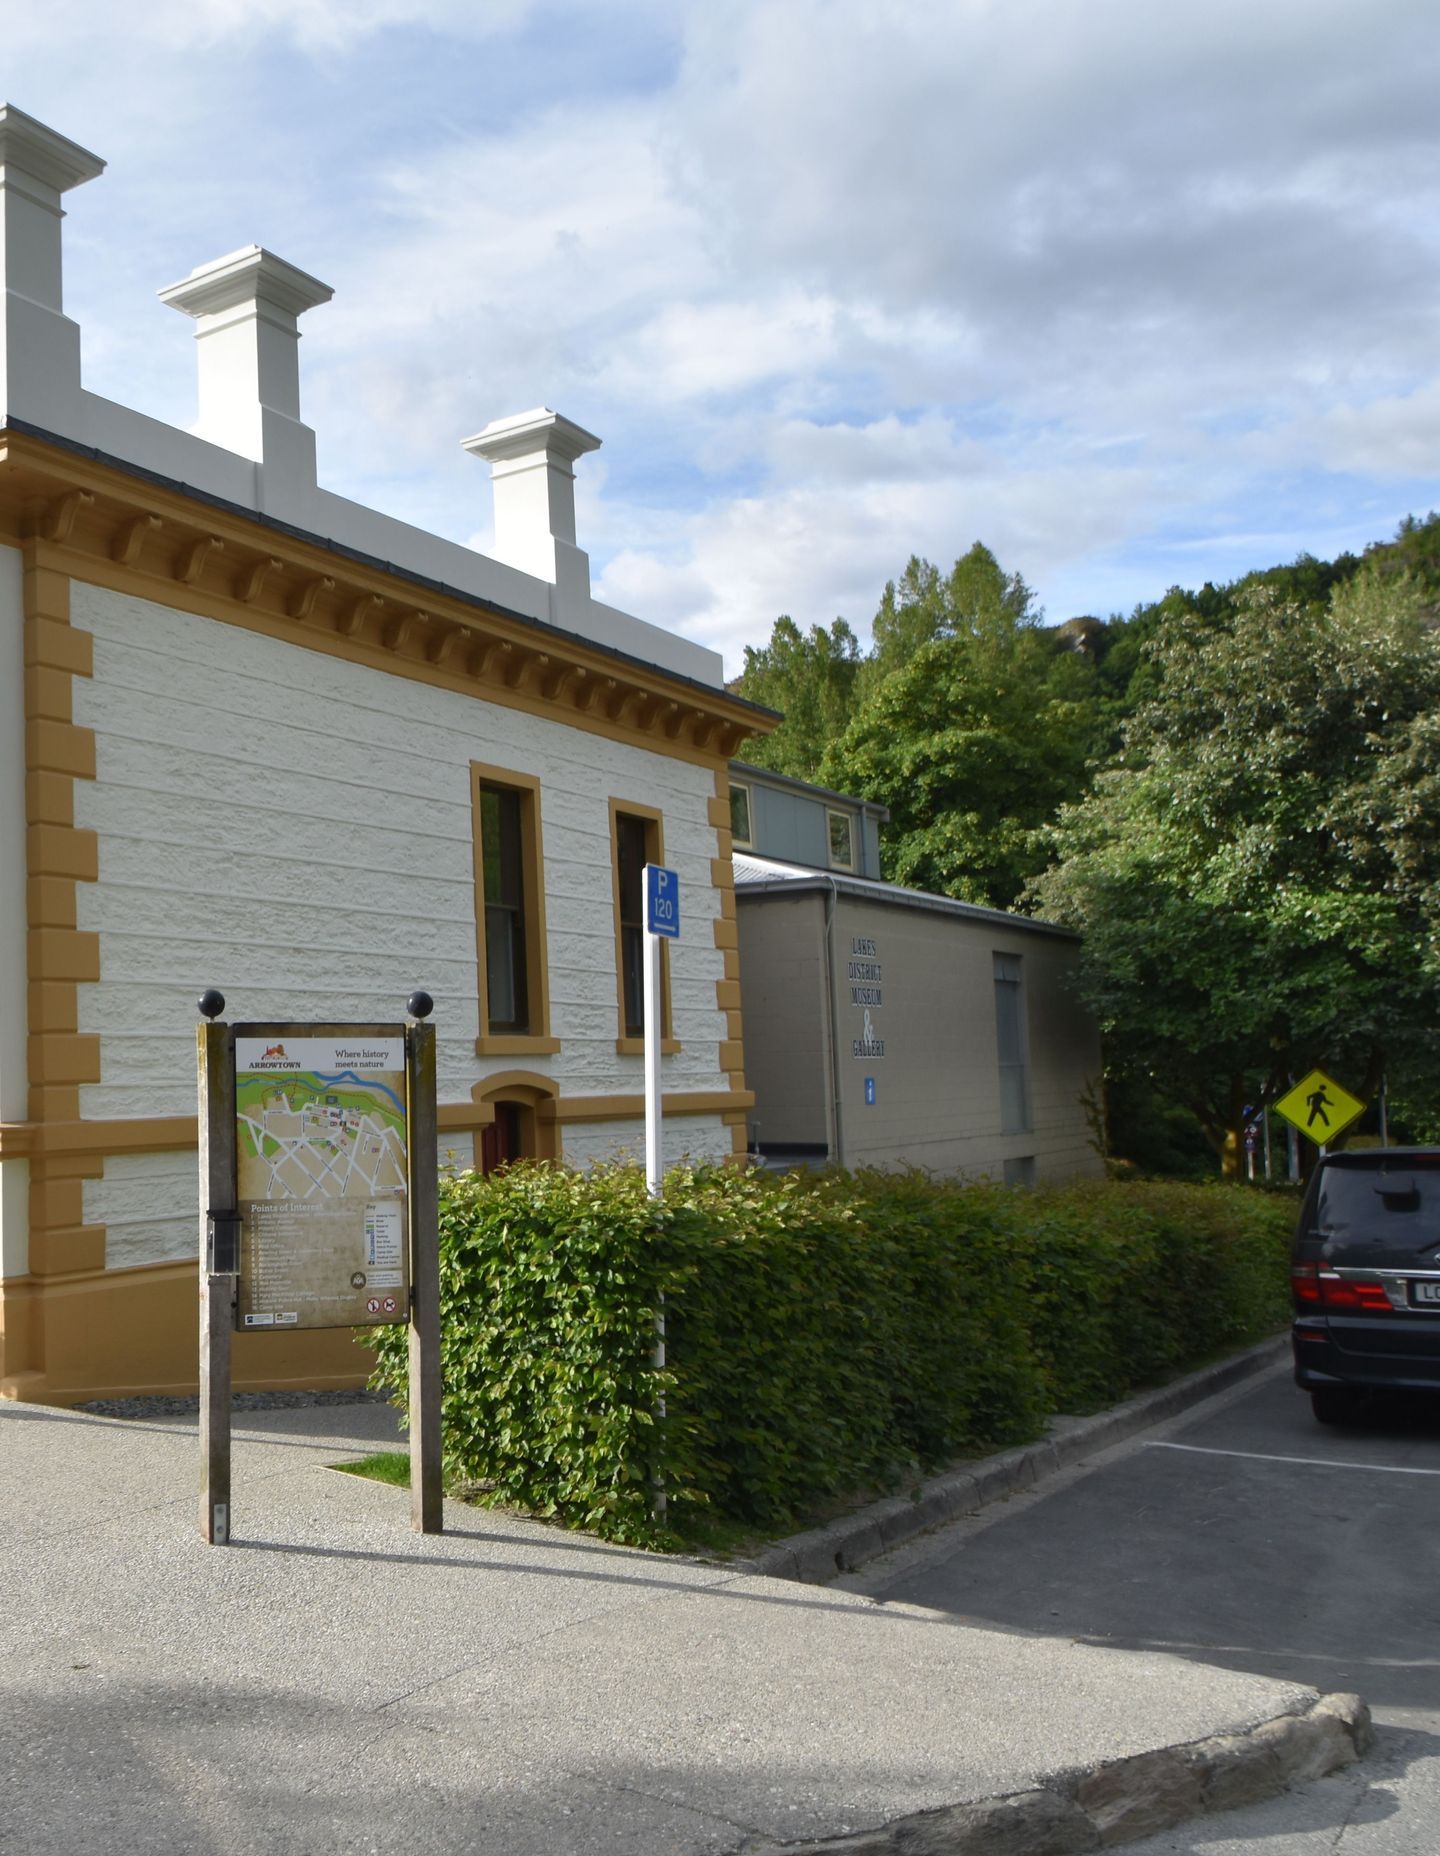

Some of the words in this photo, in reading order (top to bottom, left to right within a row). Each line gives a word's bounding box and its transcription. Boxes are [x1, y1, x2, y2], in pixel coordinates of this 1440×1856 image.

[658, 871, 668, 895] P
[654, 897, 672, 920] 120
[852, 937, 876, 957] LAKES
[848, 962, 882, 982] DISTRICT
[851, 987, 882, 1007] MUSEUM
[335, 1049, 361, 1059] Where
[362, 1049, 390, 1060] history
[853, 1040, 885, 1059] GALLERY
[248, 1061, 301, 1069] ARROWTOWN
[335, 1060, 358, 1068] meets
[359, 1060, 384, 1068] nature
[250, 1204, 278, 1213] Points
[279, 1203, 289, 1213] of
